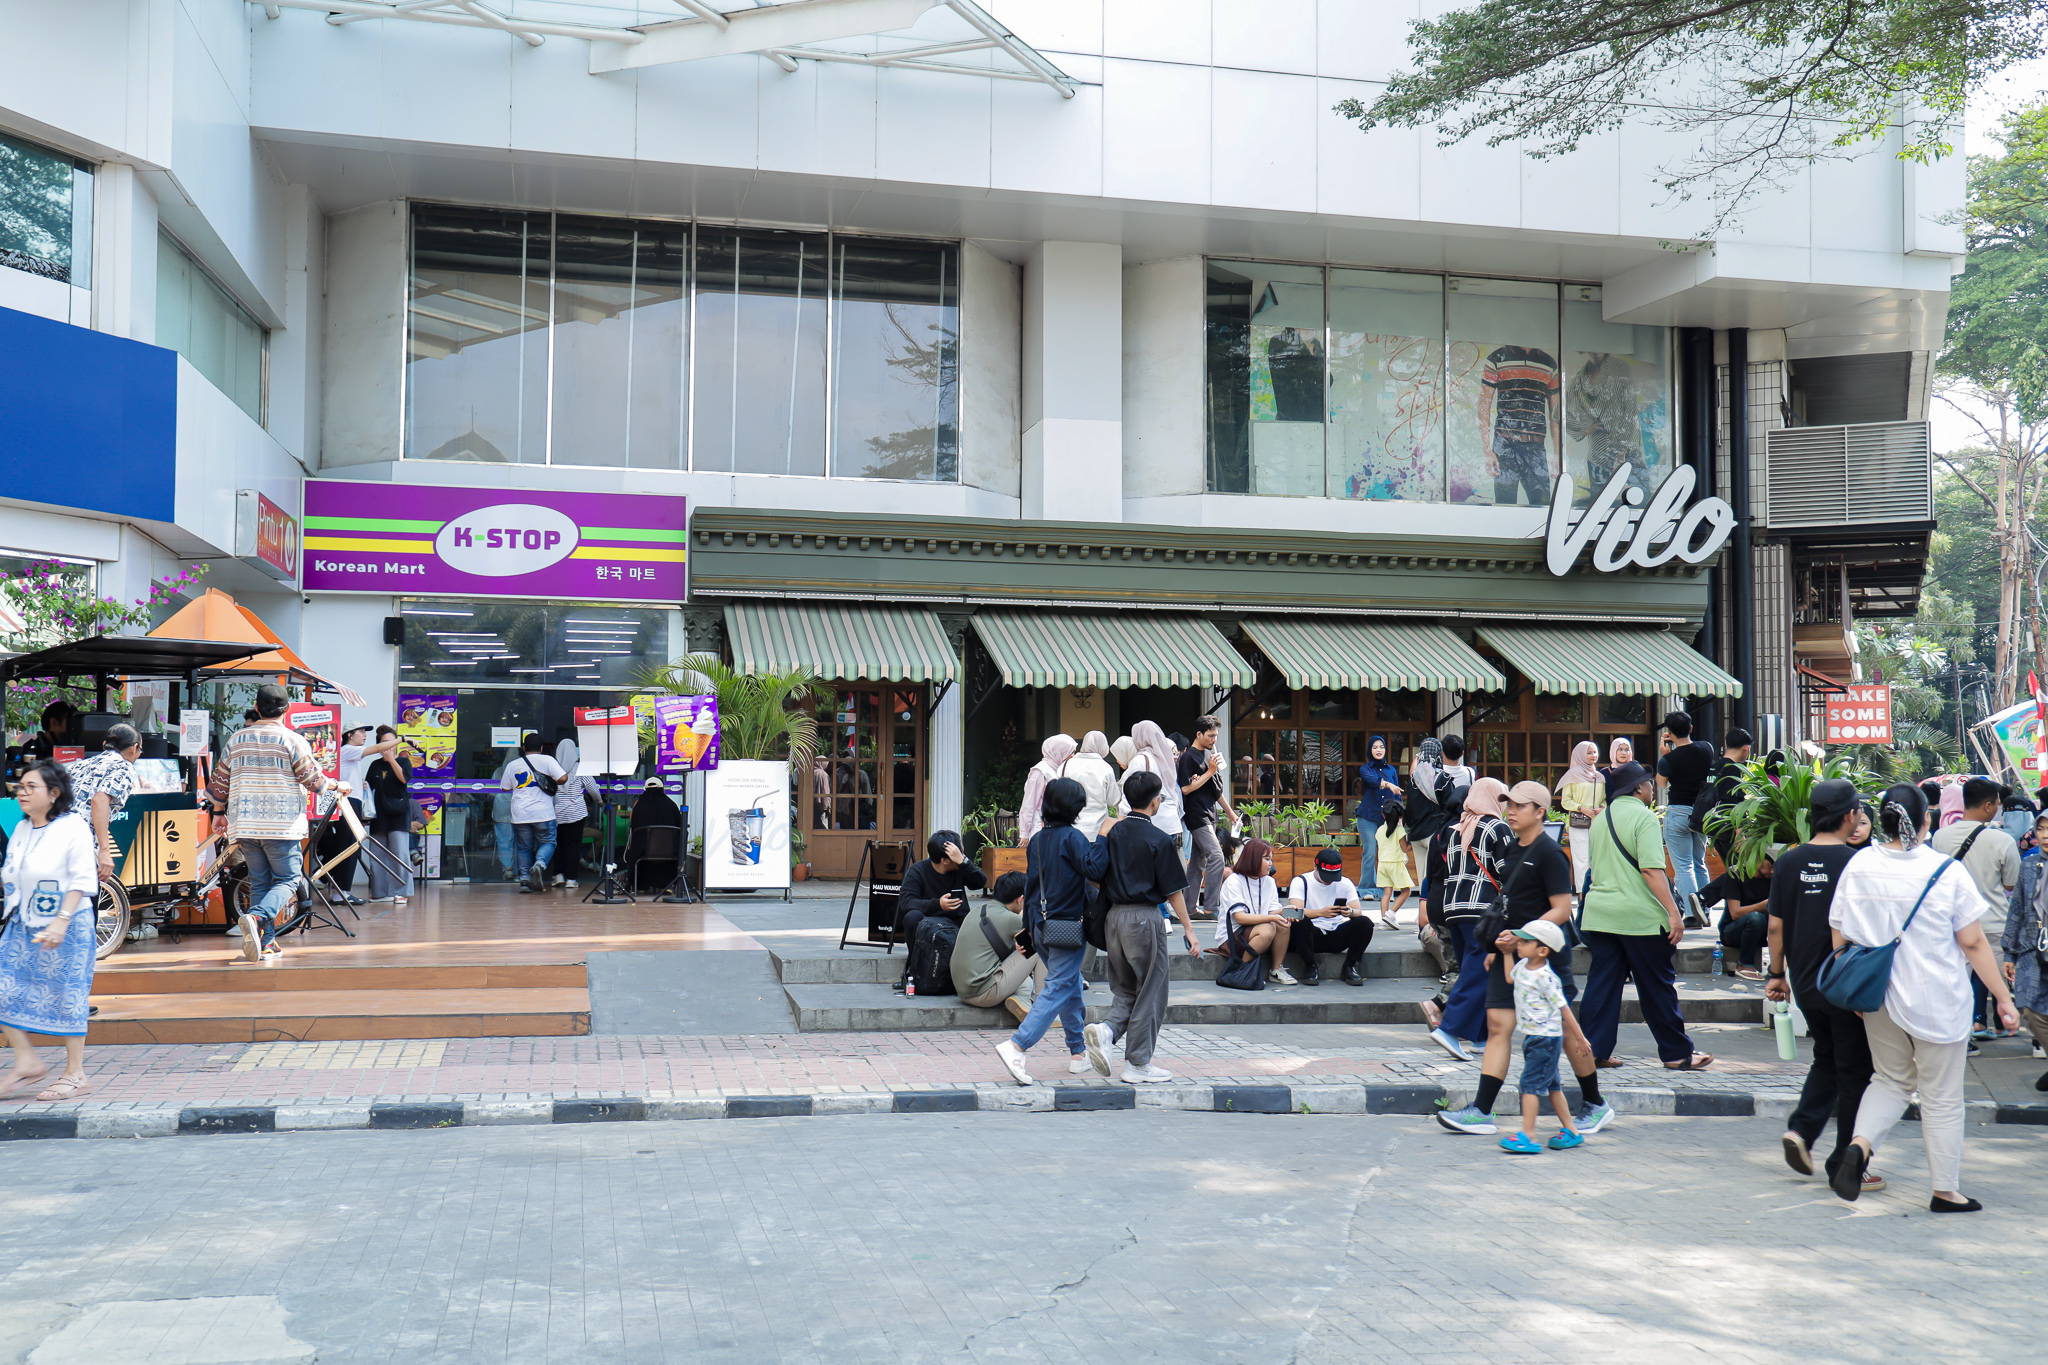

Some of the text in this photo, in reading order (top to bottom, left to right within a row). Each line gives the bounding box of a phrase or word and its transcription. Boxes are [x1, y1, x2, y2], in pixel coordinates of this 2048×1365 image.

[1546, 462, 1738, 577] Vilo
[259, 501, 284, 563] Pintu 1
[454, 527, 561, 550] K-STOP
[258, 540, 278, 561] Entrance
[315, 559, 426, 575] Korean Mart
[596, 566, 656, 581] 한국 마트
[1829, 689, 1886, 702] MAKE
[663, 710, 692, 719] SUMMER
[665, 716, 695, 726] DESSERT
[1829, 708, 1887, 721] SOME
[1829, 725, 1888, 739] ROOM
